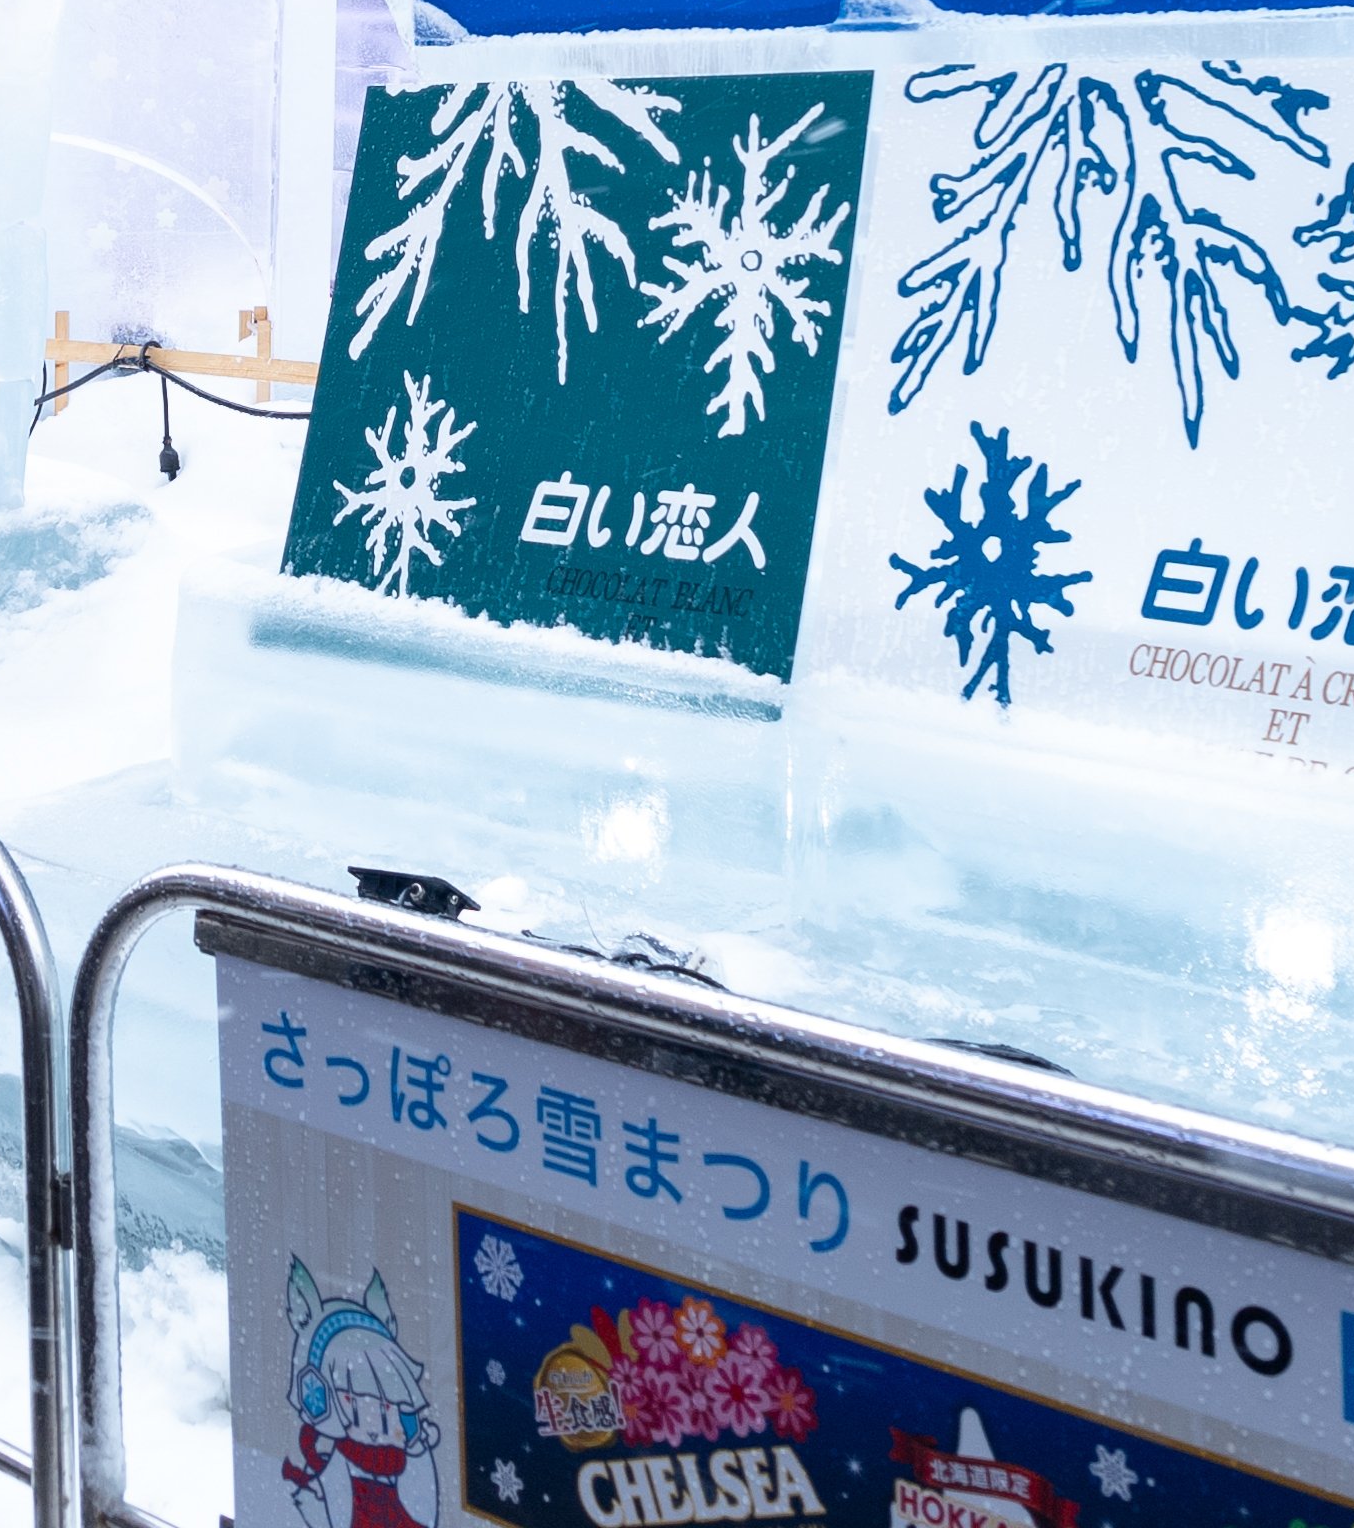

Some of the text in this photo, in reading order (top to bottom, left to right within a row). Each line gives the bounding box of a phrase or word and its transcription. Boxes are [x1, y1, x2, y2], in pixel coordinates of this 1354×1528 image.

[521, 470, 766, 570] 白い恋人
[546, 565, 754, 618] CHOCOLAT BLANC
[1130, 644, 1290, 696] CHOCOLAT
[1291, 656, 1316, 701] À
[1262, 709, 1310, 745] ET
[261, 1010, 851, 1255] さっぽろ雪まつり
[577, 1444, 827, 1528] CHELSEA
[930, 1458, 1031, 1500] 北海道限定
